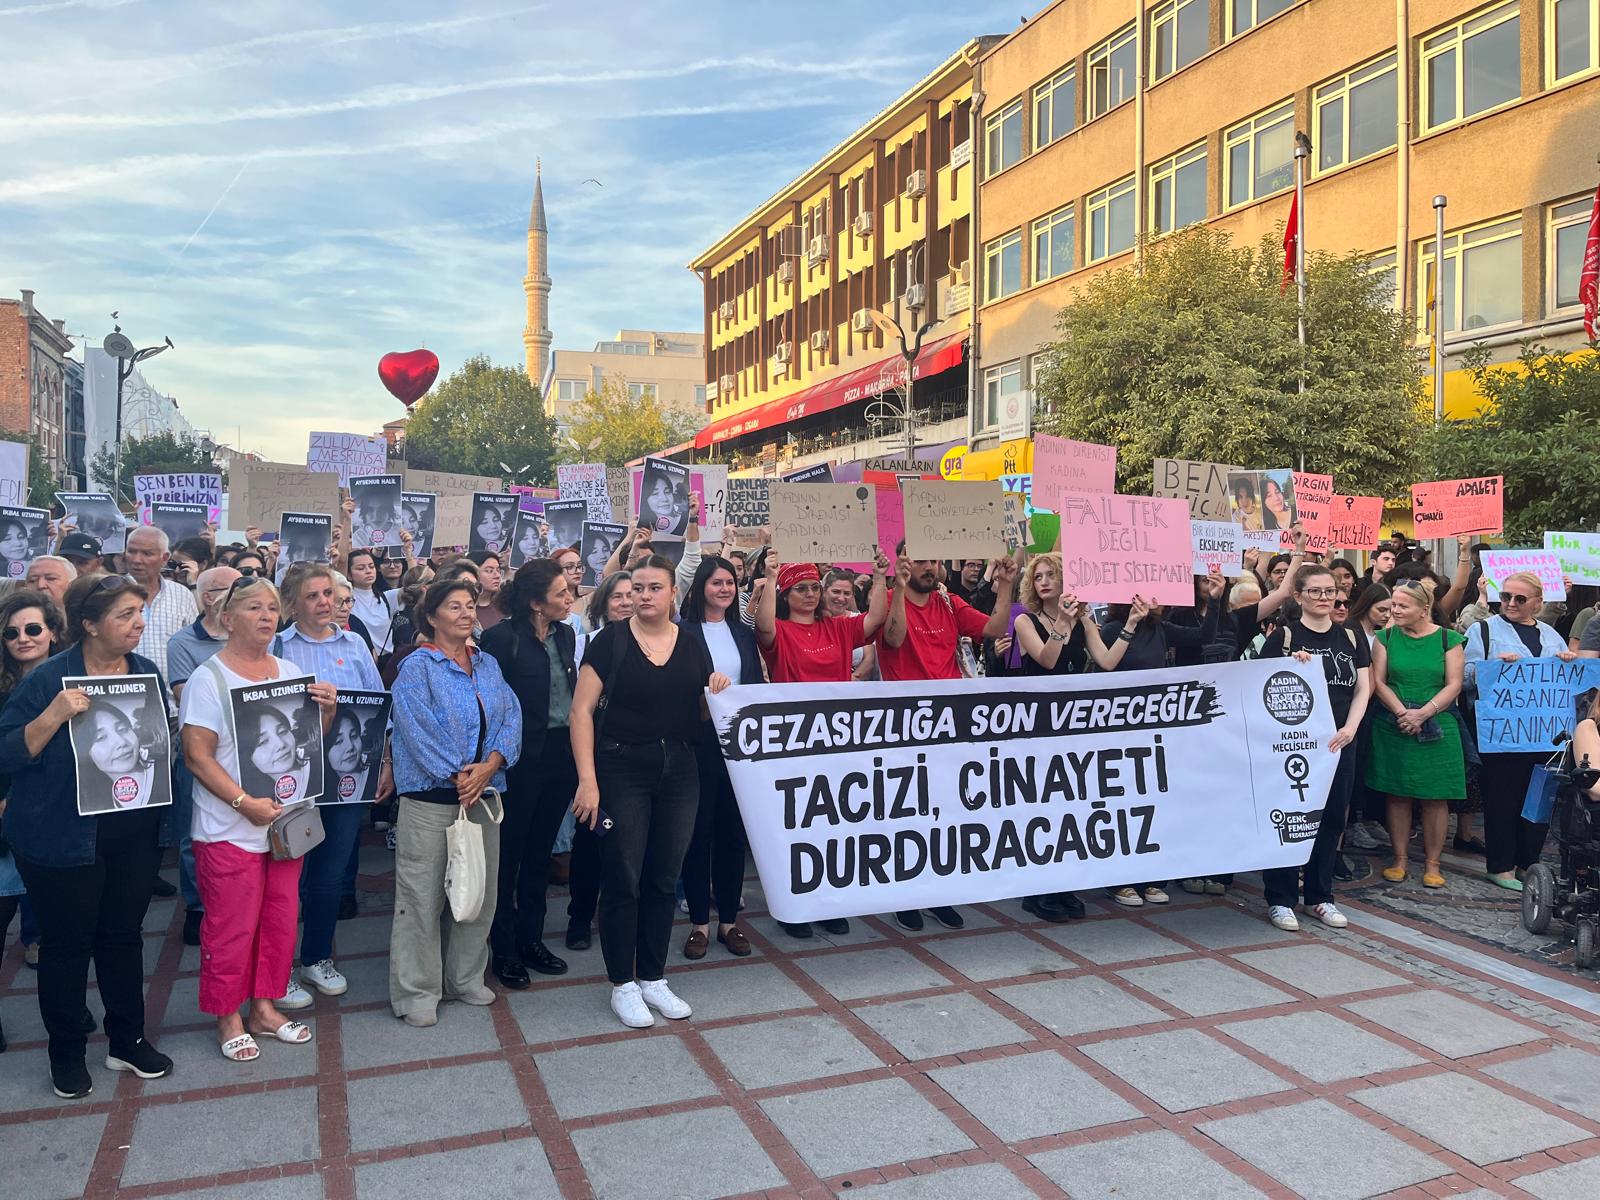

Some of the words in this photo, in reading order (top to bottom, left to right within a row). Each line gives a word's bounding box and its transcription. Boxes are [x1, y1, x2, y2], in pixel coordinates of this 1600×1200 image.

[864, 459, 934, 471] KALANLARIN
[138, 475, 165, 492] SEN
[168, 475, 195, 489] BEN
[199, 475, 219, 489] BİZ
[1164, 460, 1230, 497] BEN
[1456, 479, 1498, 497] ADALET
[1127, 499, 1168, 529] TEK
[1271, 676, 1299, 686] KADIN
[1497, 661, 1585, 686] KATLİAM
[108, 683, 147, 695] UZUNER
[242, 689, 270, 703] İKBAL
[270, 683, 306, 698] UZUNER
[1492, 688, 1571, 709] YASANIZI
[336, 695, 354, 704] KBAL
[356, 696, 385, 705] UZUNER
[737, 699, 957, 756] CEZASIZLIĞA
[969, 701, 1038, 736] SON
[1050, 683, 1204, 731] VERECEĞİZ
[1281, 731, 1309, 741] KADIN
[1272, 739, 1318, 753] MECLİSLERİ
[774, 752, 941, 830] TACİZİ,
[957, 733, 1170, 812] CİNAYETİ
[789, 800, 1161, 896] DURDURACAĞIZ
